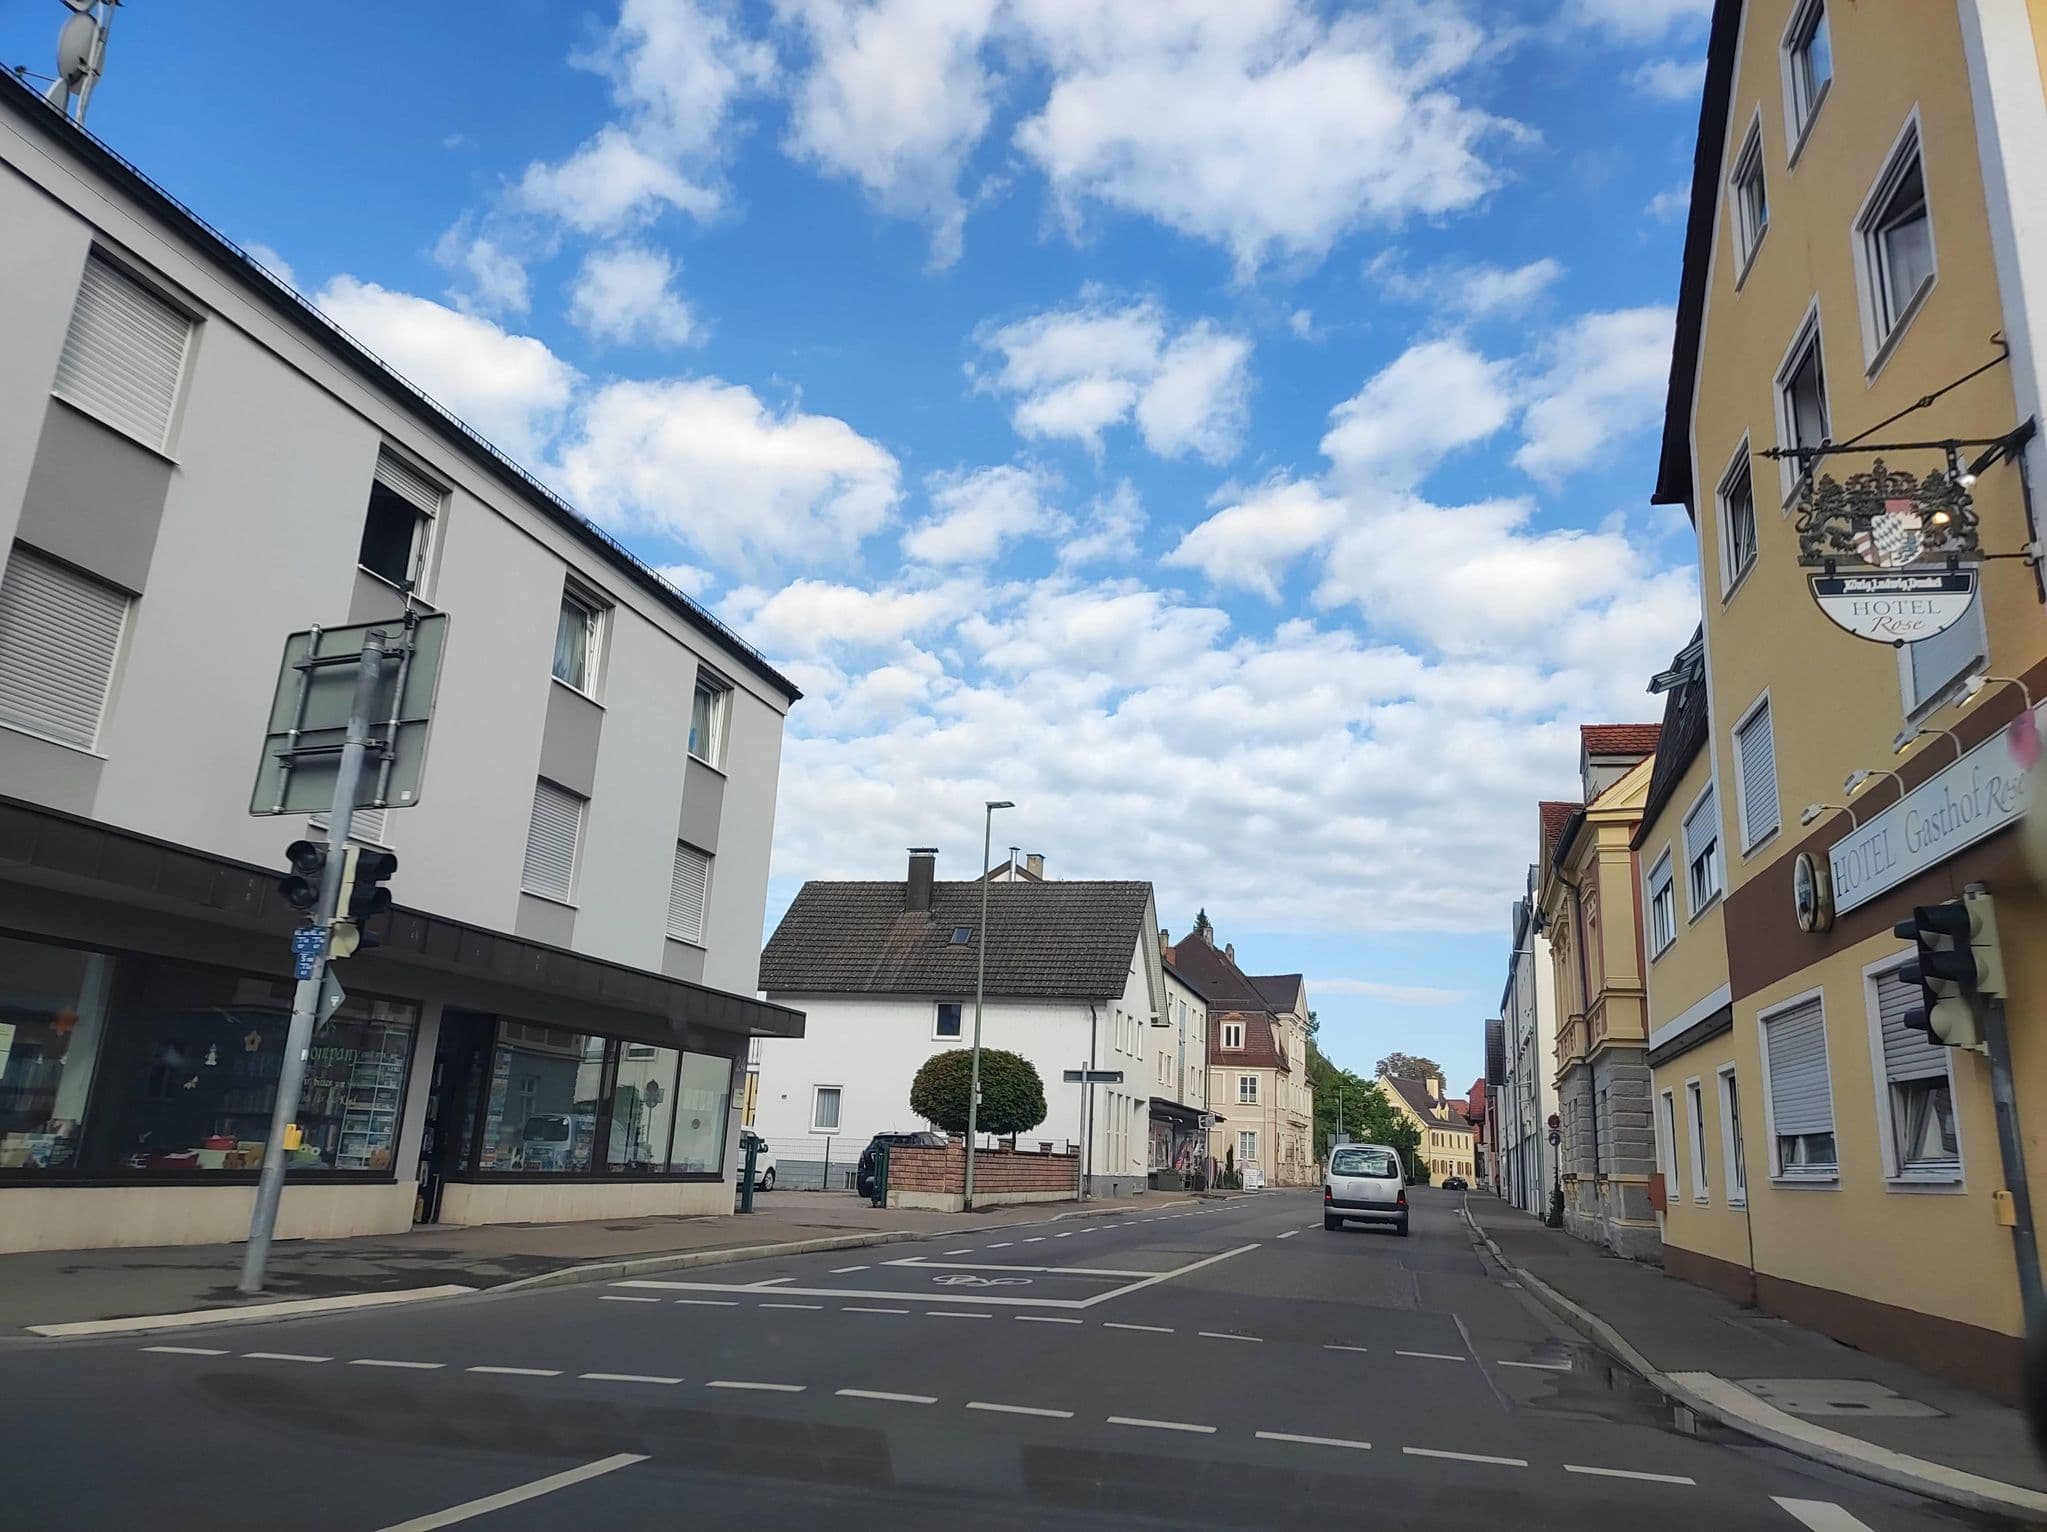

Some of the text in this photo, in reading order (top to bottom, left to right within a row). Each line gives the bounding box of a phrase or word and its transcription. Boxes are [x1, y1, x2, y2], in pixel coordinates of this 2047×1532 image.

[1852, 599, 1942, 617] HOTEL
[1871, 615, 1926, 636] Rose
[1833, 765, 2026, 898] HOTEL Gasthof Rose
[309, 1046, 358, 1067] ompany
